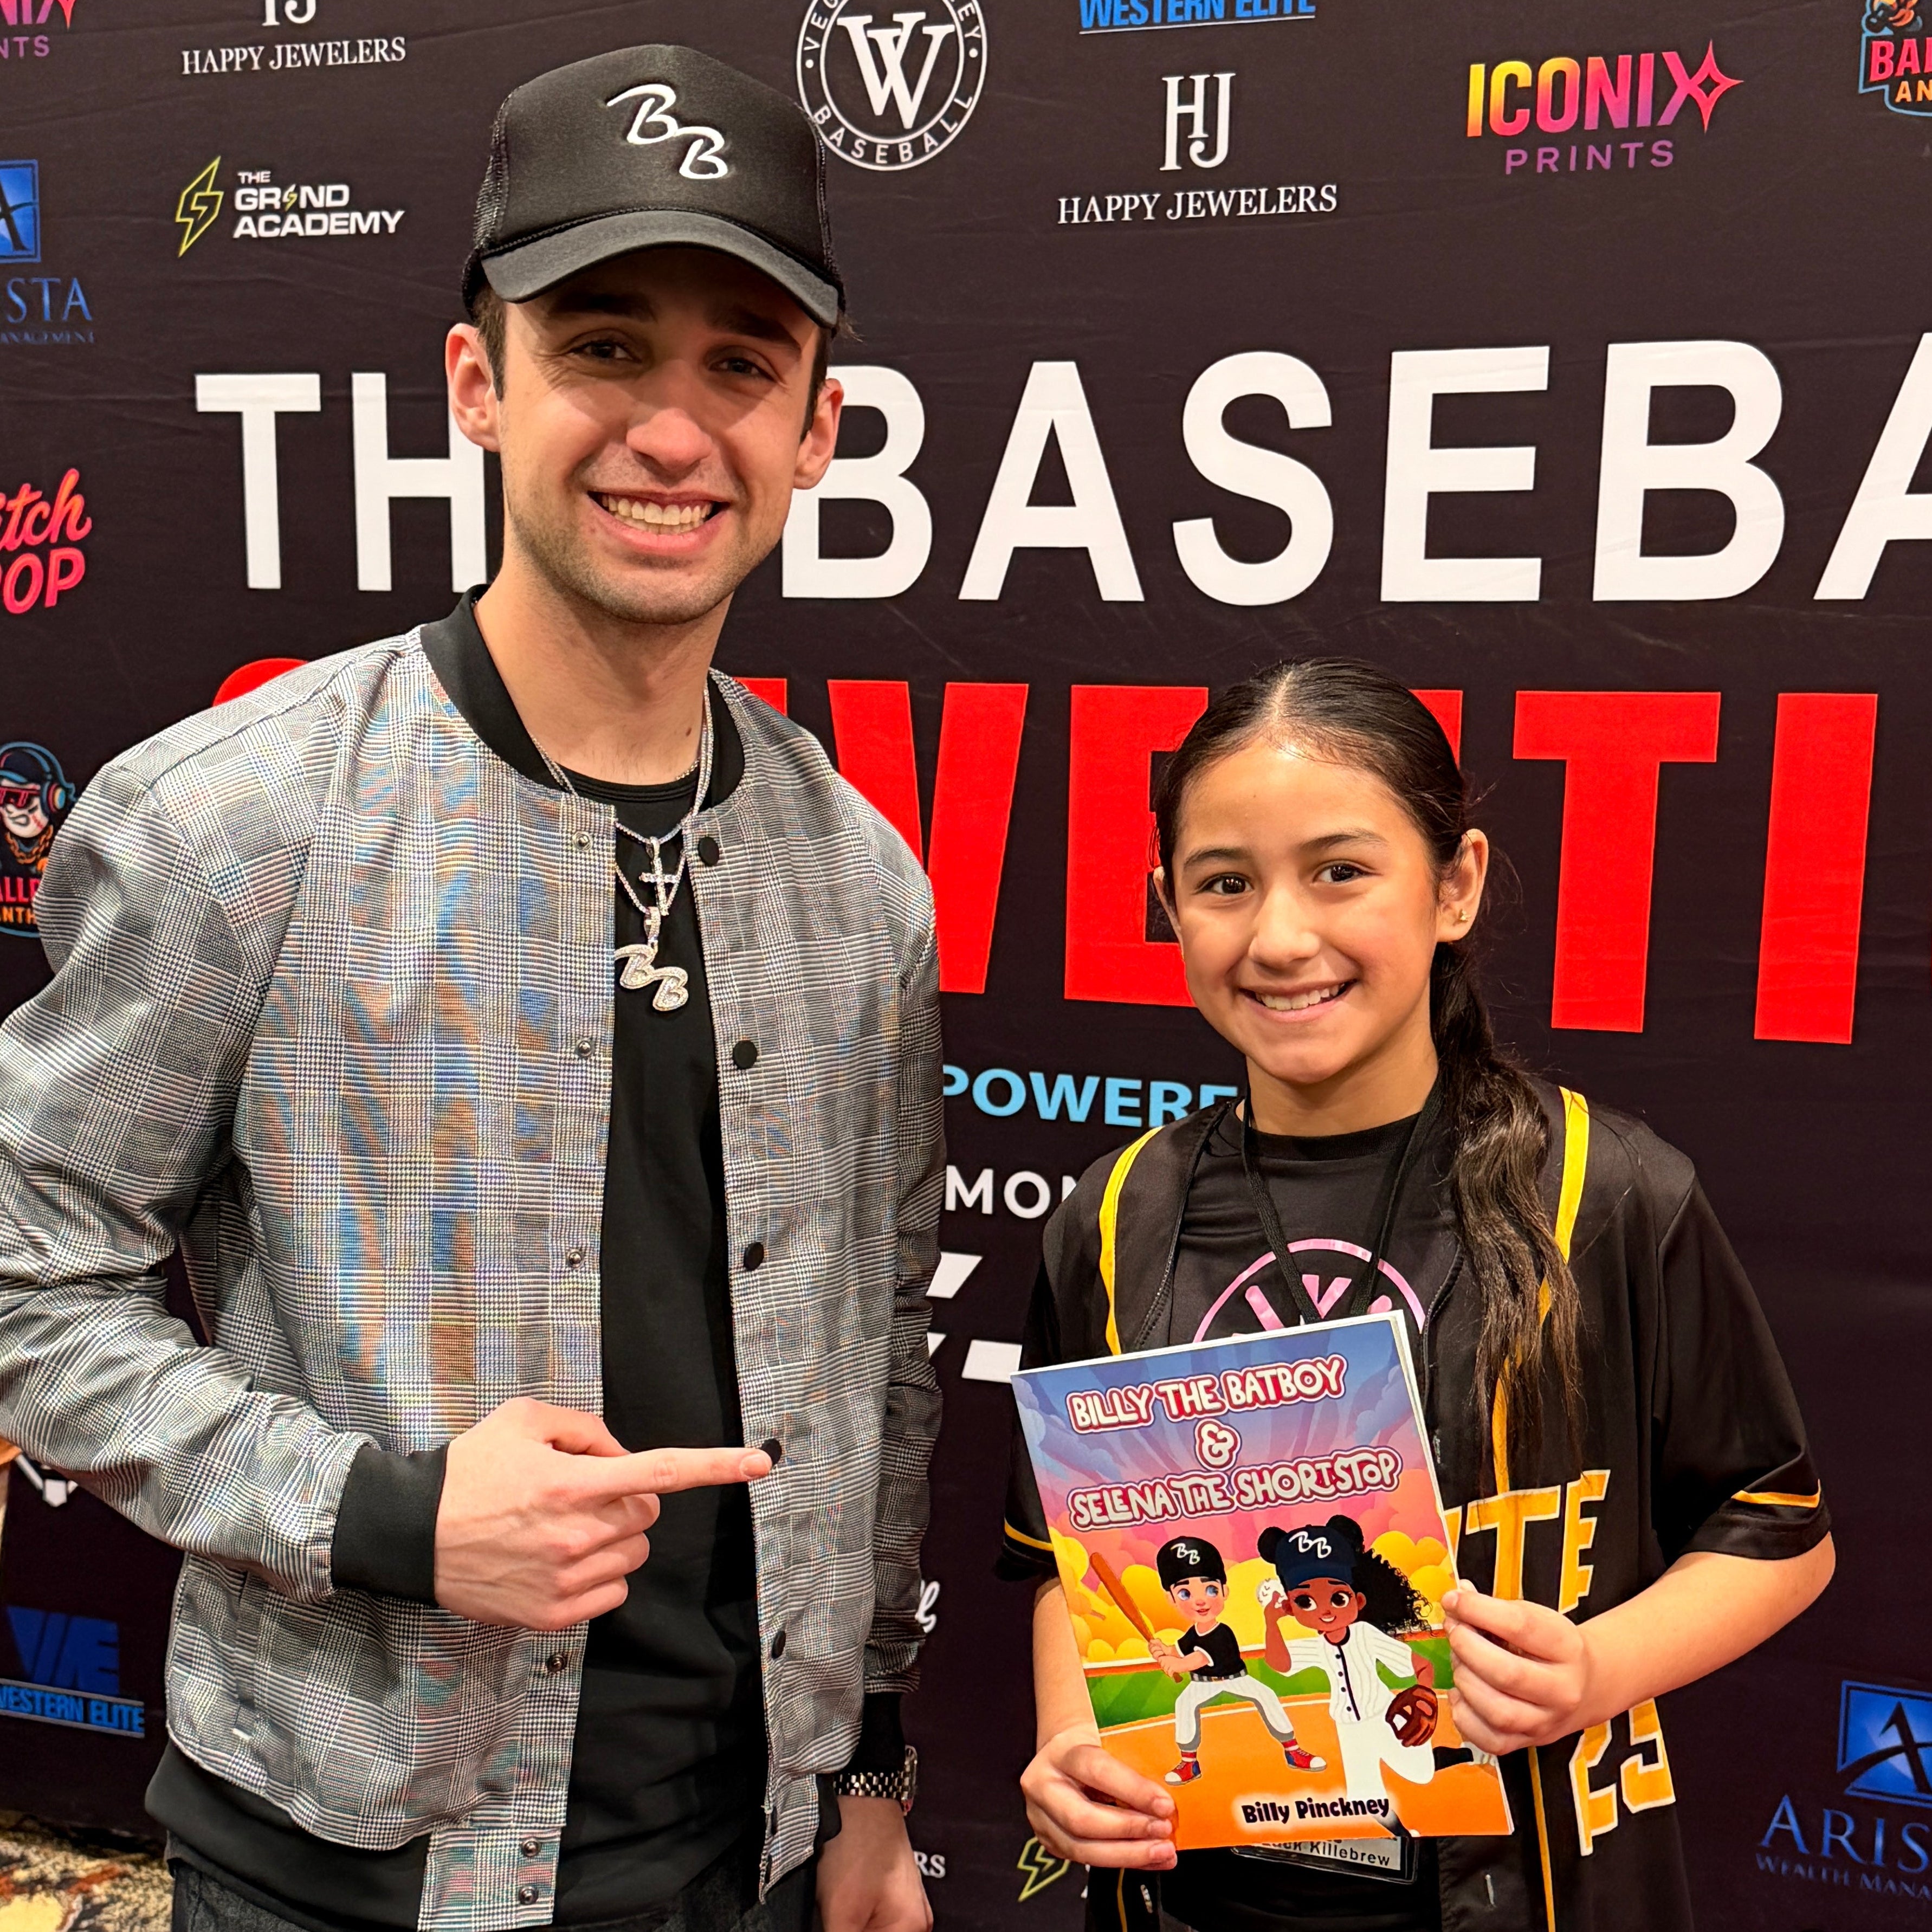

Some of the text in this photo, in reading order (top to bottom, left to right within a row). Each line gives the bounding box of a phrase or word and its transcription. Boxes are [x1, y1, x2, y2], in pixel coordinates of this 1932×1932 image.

[182, 36, 406, 75] HAPPY JEWELERS
[1466, 40, 1744, 138] ICONIX
[607, 84, 728, 179] BB
[814, 96, 973, 164] BASEBALL
[1160, 73, 1236, 171] HJ
[237, 171, 271, 184] THE
[1505, 140, 1674, 175] PRINTS
[233, 211, 405, 238] ACADEMY
[1058, 184, 1337, 224] HAPPY JEWELERS
[0, 468, 92, 551] tch
[194, 372, 488, 592] TH
[0, 547, 85, 614] OP
[1070, 1356, 1343, 1430] BILLY THE BATBOY
[1198, 1420, 1238, 1468] &
[1072, 1451, 1398, 1527] SELENA THE SHORTSTOP
[89, 1700, 145, 1733] ELITE
[1242, 1797, 1389, 1824] Billy Pinckney
[1309, 1841, 1390, 1866] Killebrew
